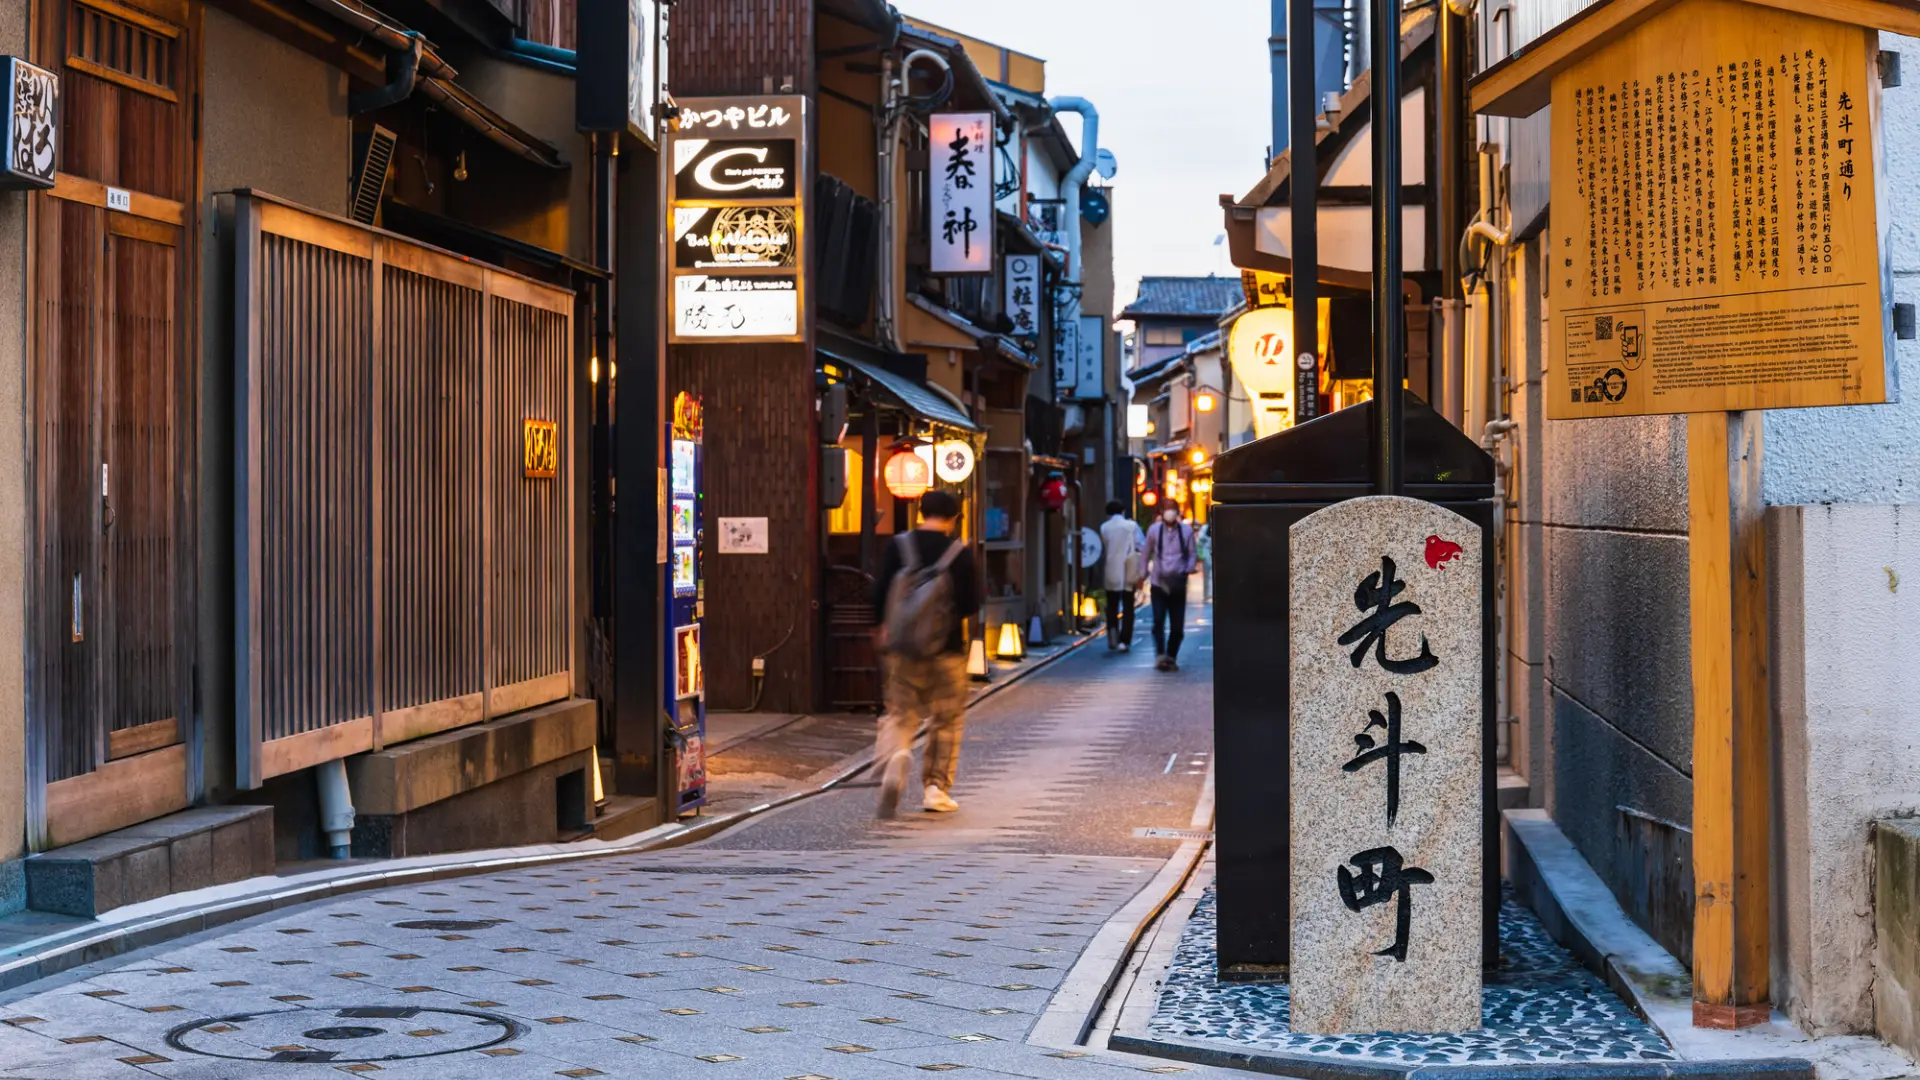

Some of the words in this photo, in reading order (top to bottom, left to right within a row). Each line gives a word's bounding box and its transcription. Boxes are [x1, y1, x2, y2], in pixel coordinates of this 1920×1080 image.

[1716, 66, 1725, 107] れている。
[1779, 55, 1788, 76] ある。
[679, 104, 791, 129] かつやビル
[974, 119, 985, 153] 京料理
[1575, 90, 1585, 197] 通りとして知られている。
[1838, 92, 1854, 200] 先斗町通り
[942, 128, 978, 259] 春神
[1705, 78, 1717, 284] また、江戸時代から続く京都を代表する花街
[1564, 238, 1573, 287] 京都市
[1666, 304, 1703, 313] Pontocho-dori
[1337, 555, 1440, 962] 先斗町
